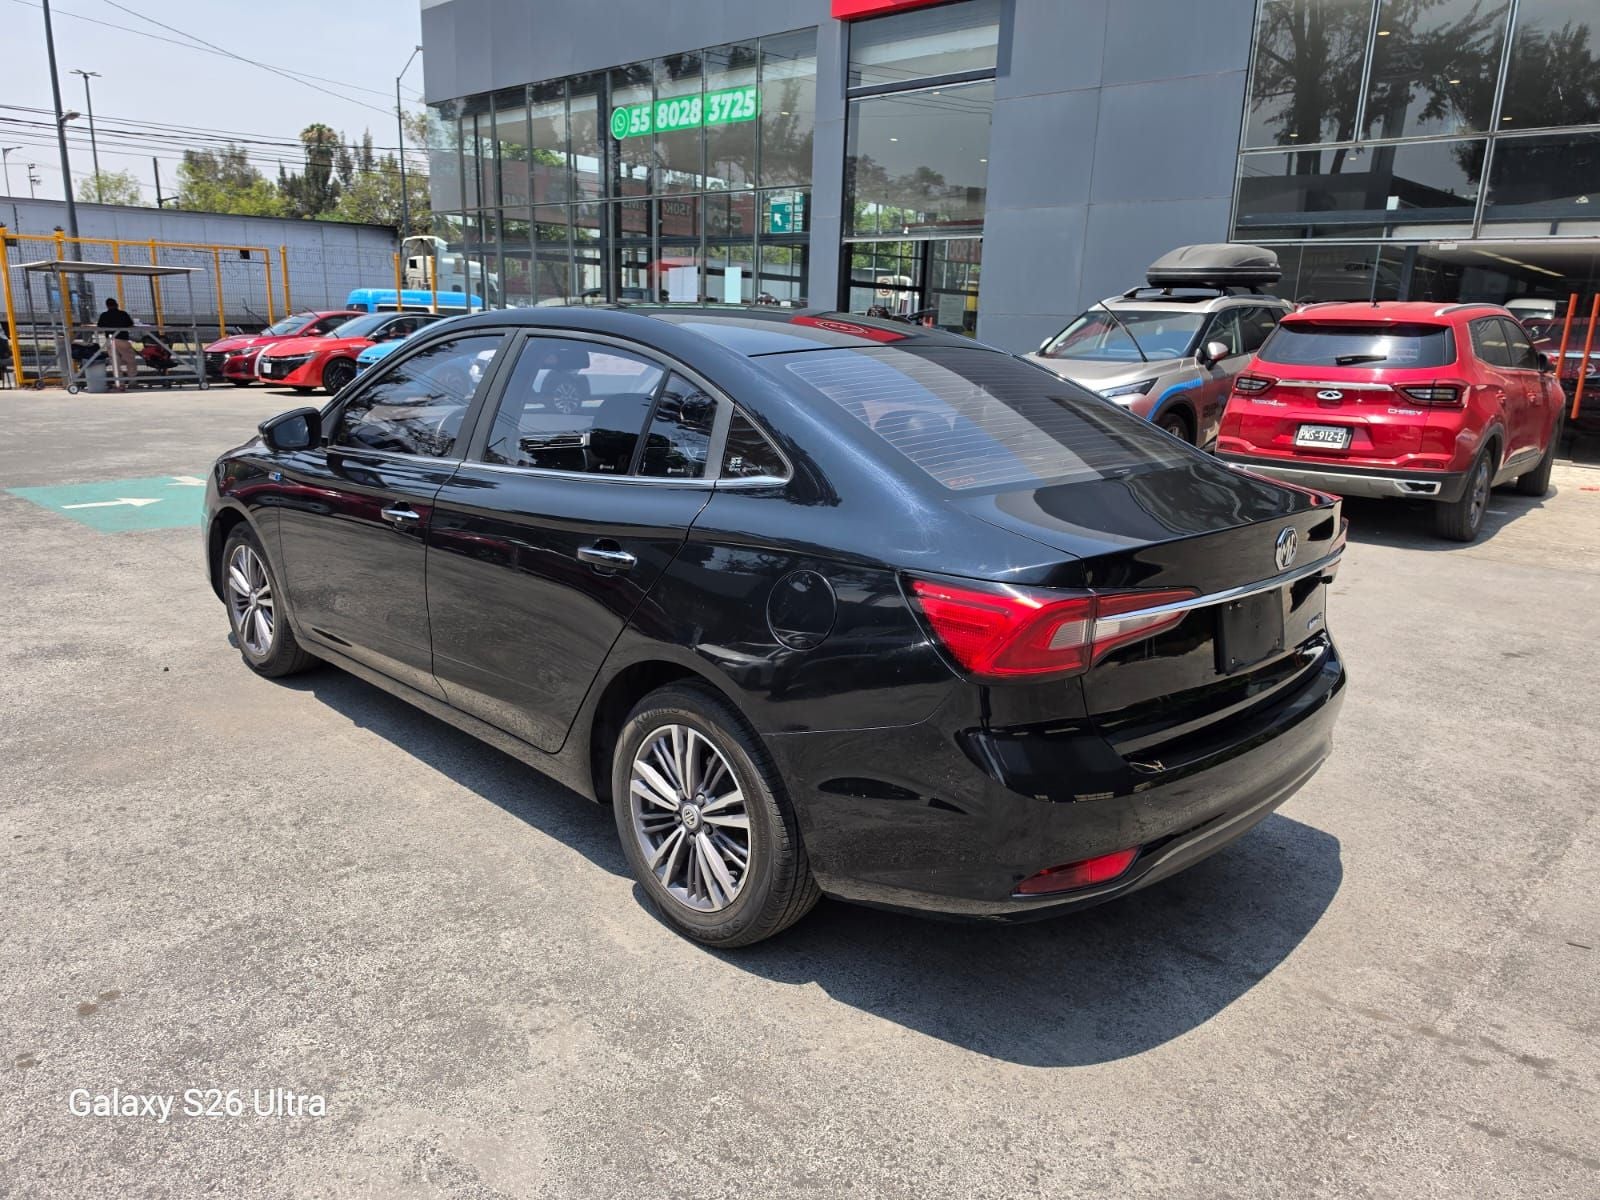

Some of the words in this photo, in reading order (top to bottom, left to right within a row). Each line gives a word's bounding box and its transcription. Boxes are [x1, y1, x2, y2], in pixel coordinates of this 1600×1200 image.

[629, 106, 651, 133] 55
[657, 98, 702, 128] 8028
[708, 89, 757, 121] 3725
